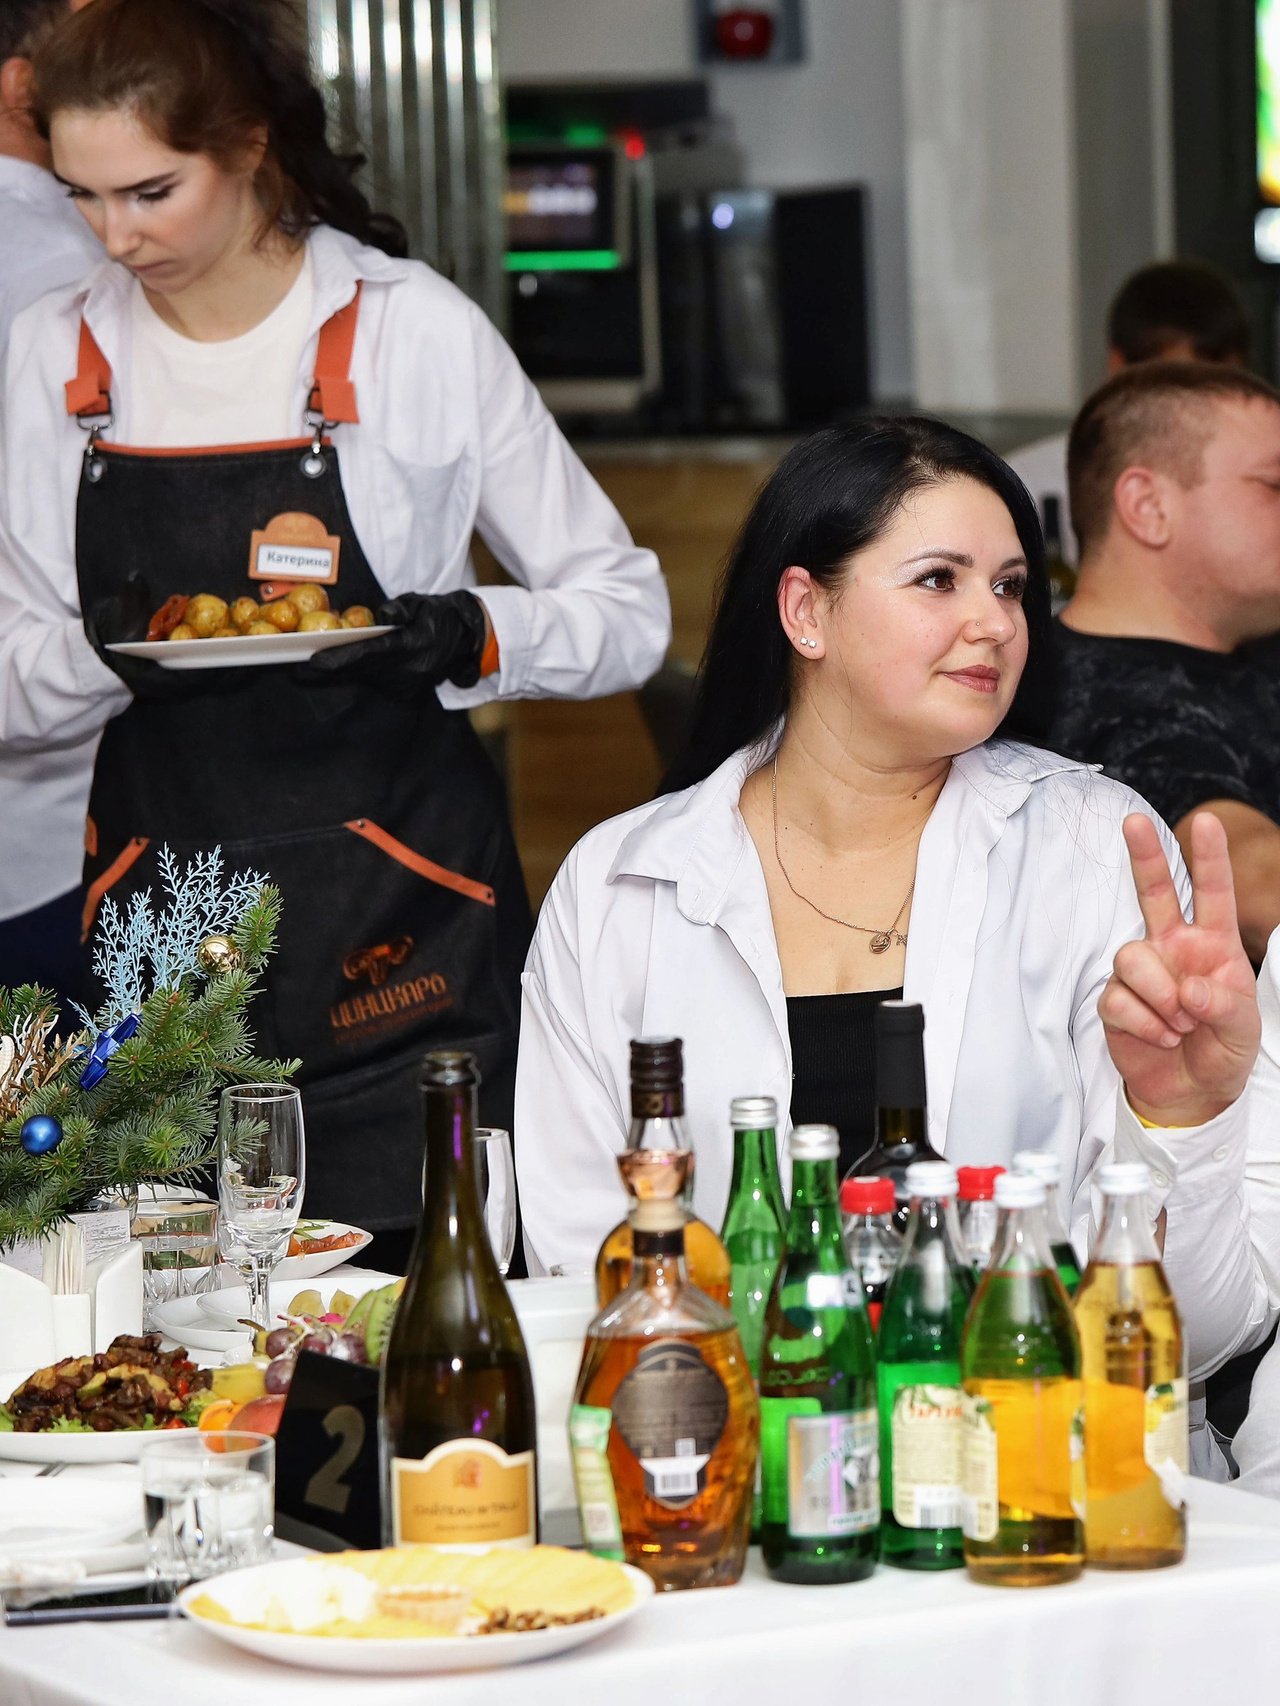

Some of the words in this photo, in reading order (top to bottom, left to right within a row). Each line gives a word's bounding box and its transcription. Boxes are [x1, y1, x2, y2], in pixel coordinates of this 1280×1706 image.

[266, 550, 330, 568] Катерина
[330, 973, 447, 1028] ЦИНЦКАРО
[305, 1404, 366, 1513] 2
